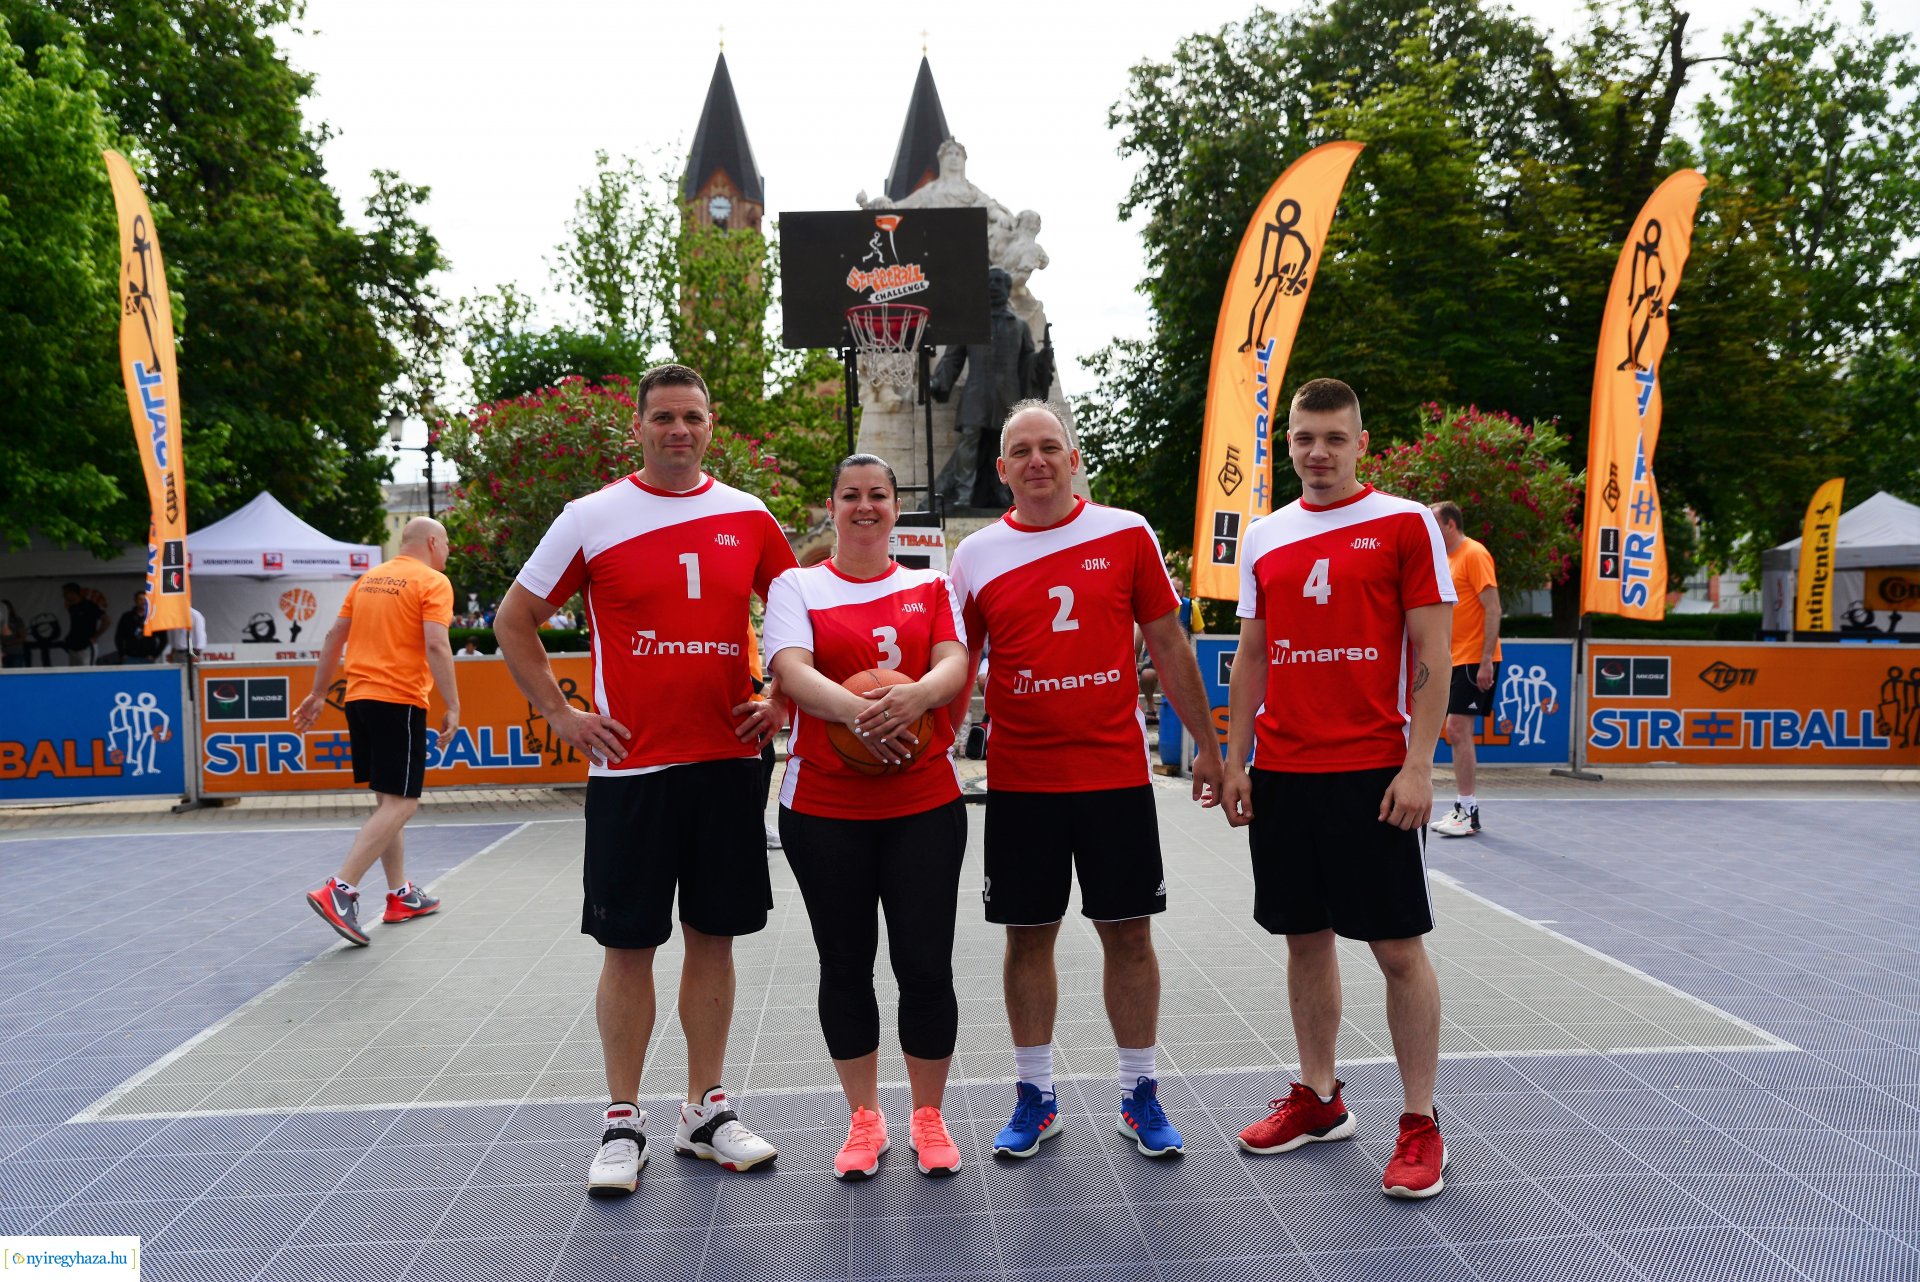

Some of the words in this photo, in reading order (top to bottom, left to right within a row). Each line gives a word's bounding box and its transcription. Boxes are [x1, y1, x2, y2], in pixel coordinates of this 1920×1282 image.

[874, 283, 927, 302] CHALLENGE
[679, 552, 701, 600] 1
[1303, 558, 1331, 605] 4
[1048, 585, 1080, 632] 2
[658, 641, 740, 656] marso
[872, 625, 902, 670] 3
[1291, 647, 1379, 664] marso
[1033, 669, 1121, 693] marso
[1712, 668, 1758, 686] TOTI
